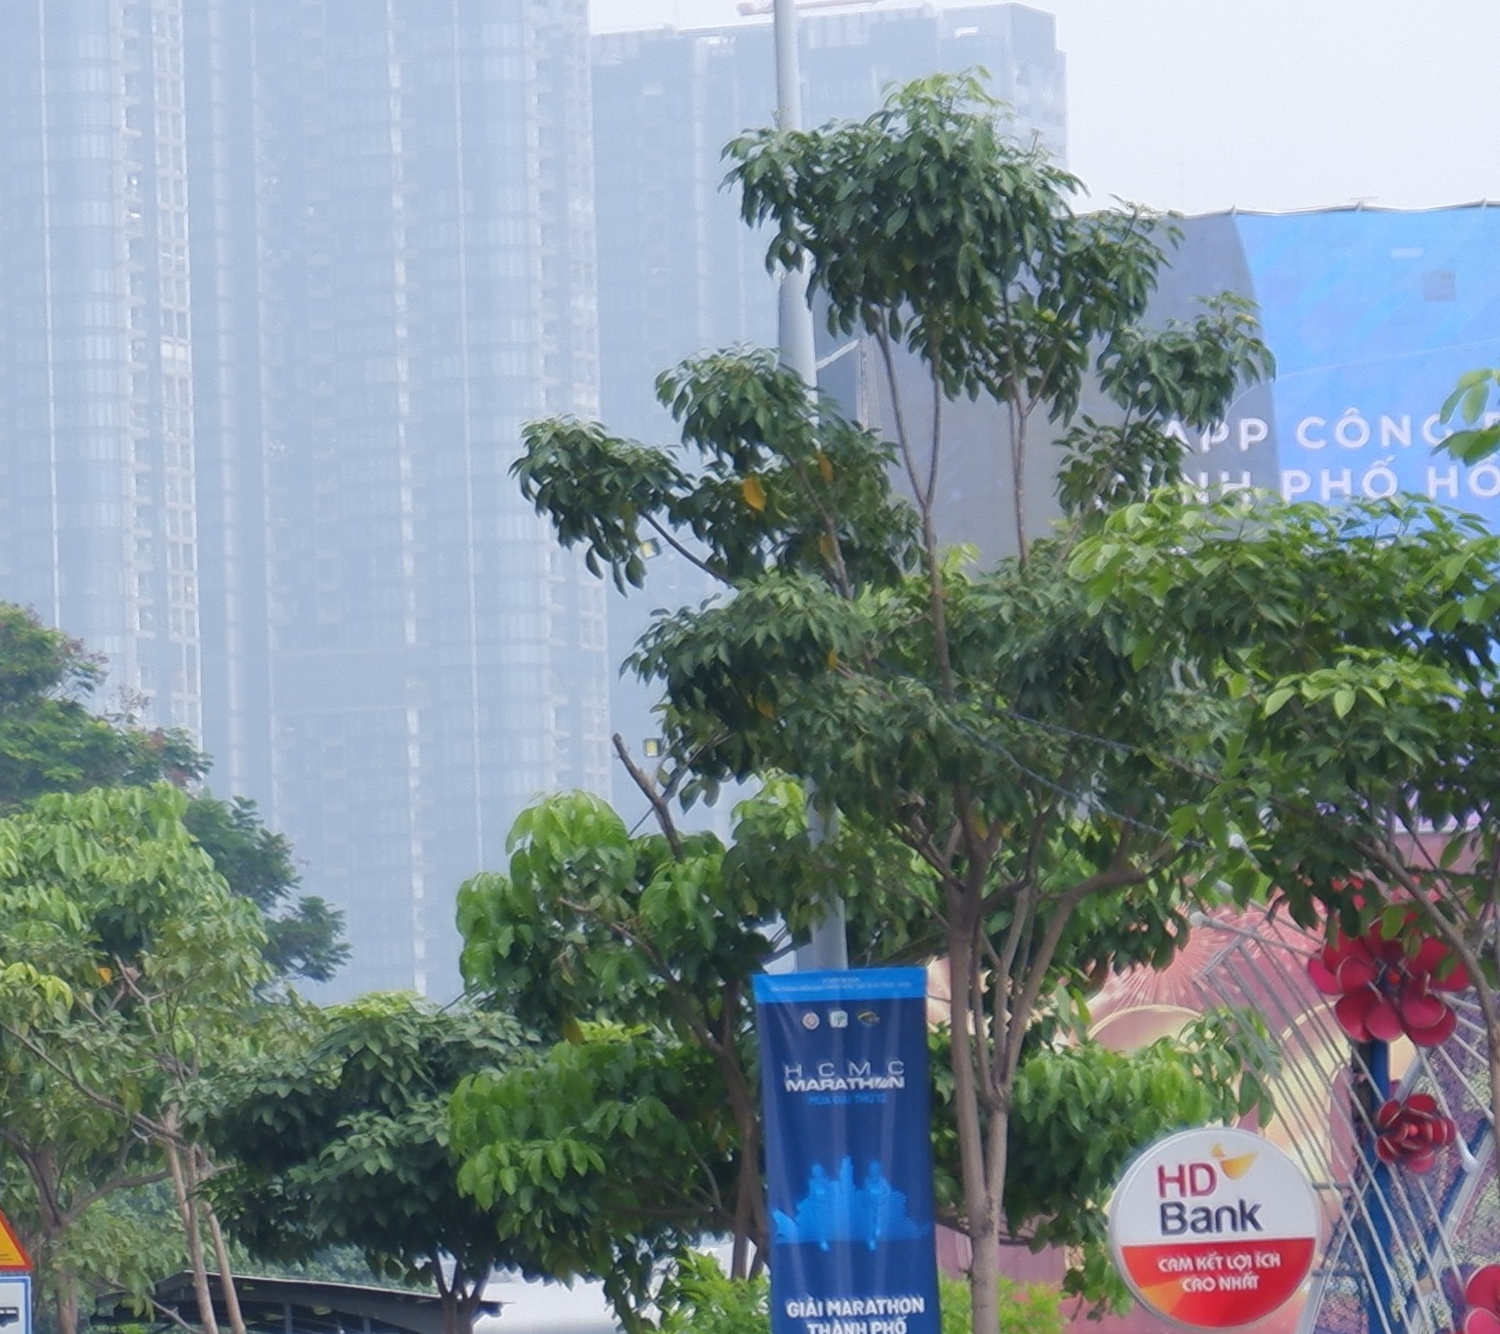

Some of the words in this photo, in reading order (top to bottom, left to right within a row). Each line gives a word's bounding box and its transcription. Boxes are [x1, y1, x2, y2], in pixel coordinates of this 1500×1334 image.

[786, 1077, 905, 1092] MARATHON
[1158, 1163, 1217, 1198] HD
[1160, 1198, 1263, 1236] Bank
[1196, 1251, 1224, 1271] KẾT
[786, 1296, 823, 1318] GIẢI
[826, 1296, 925, 1316] MARATHON
